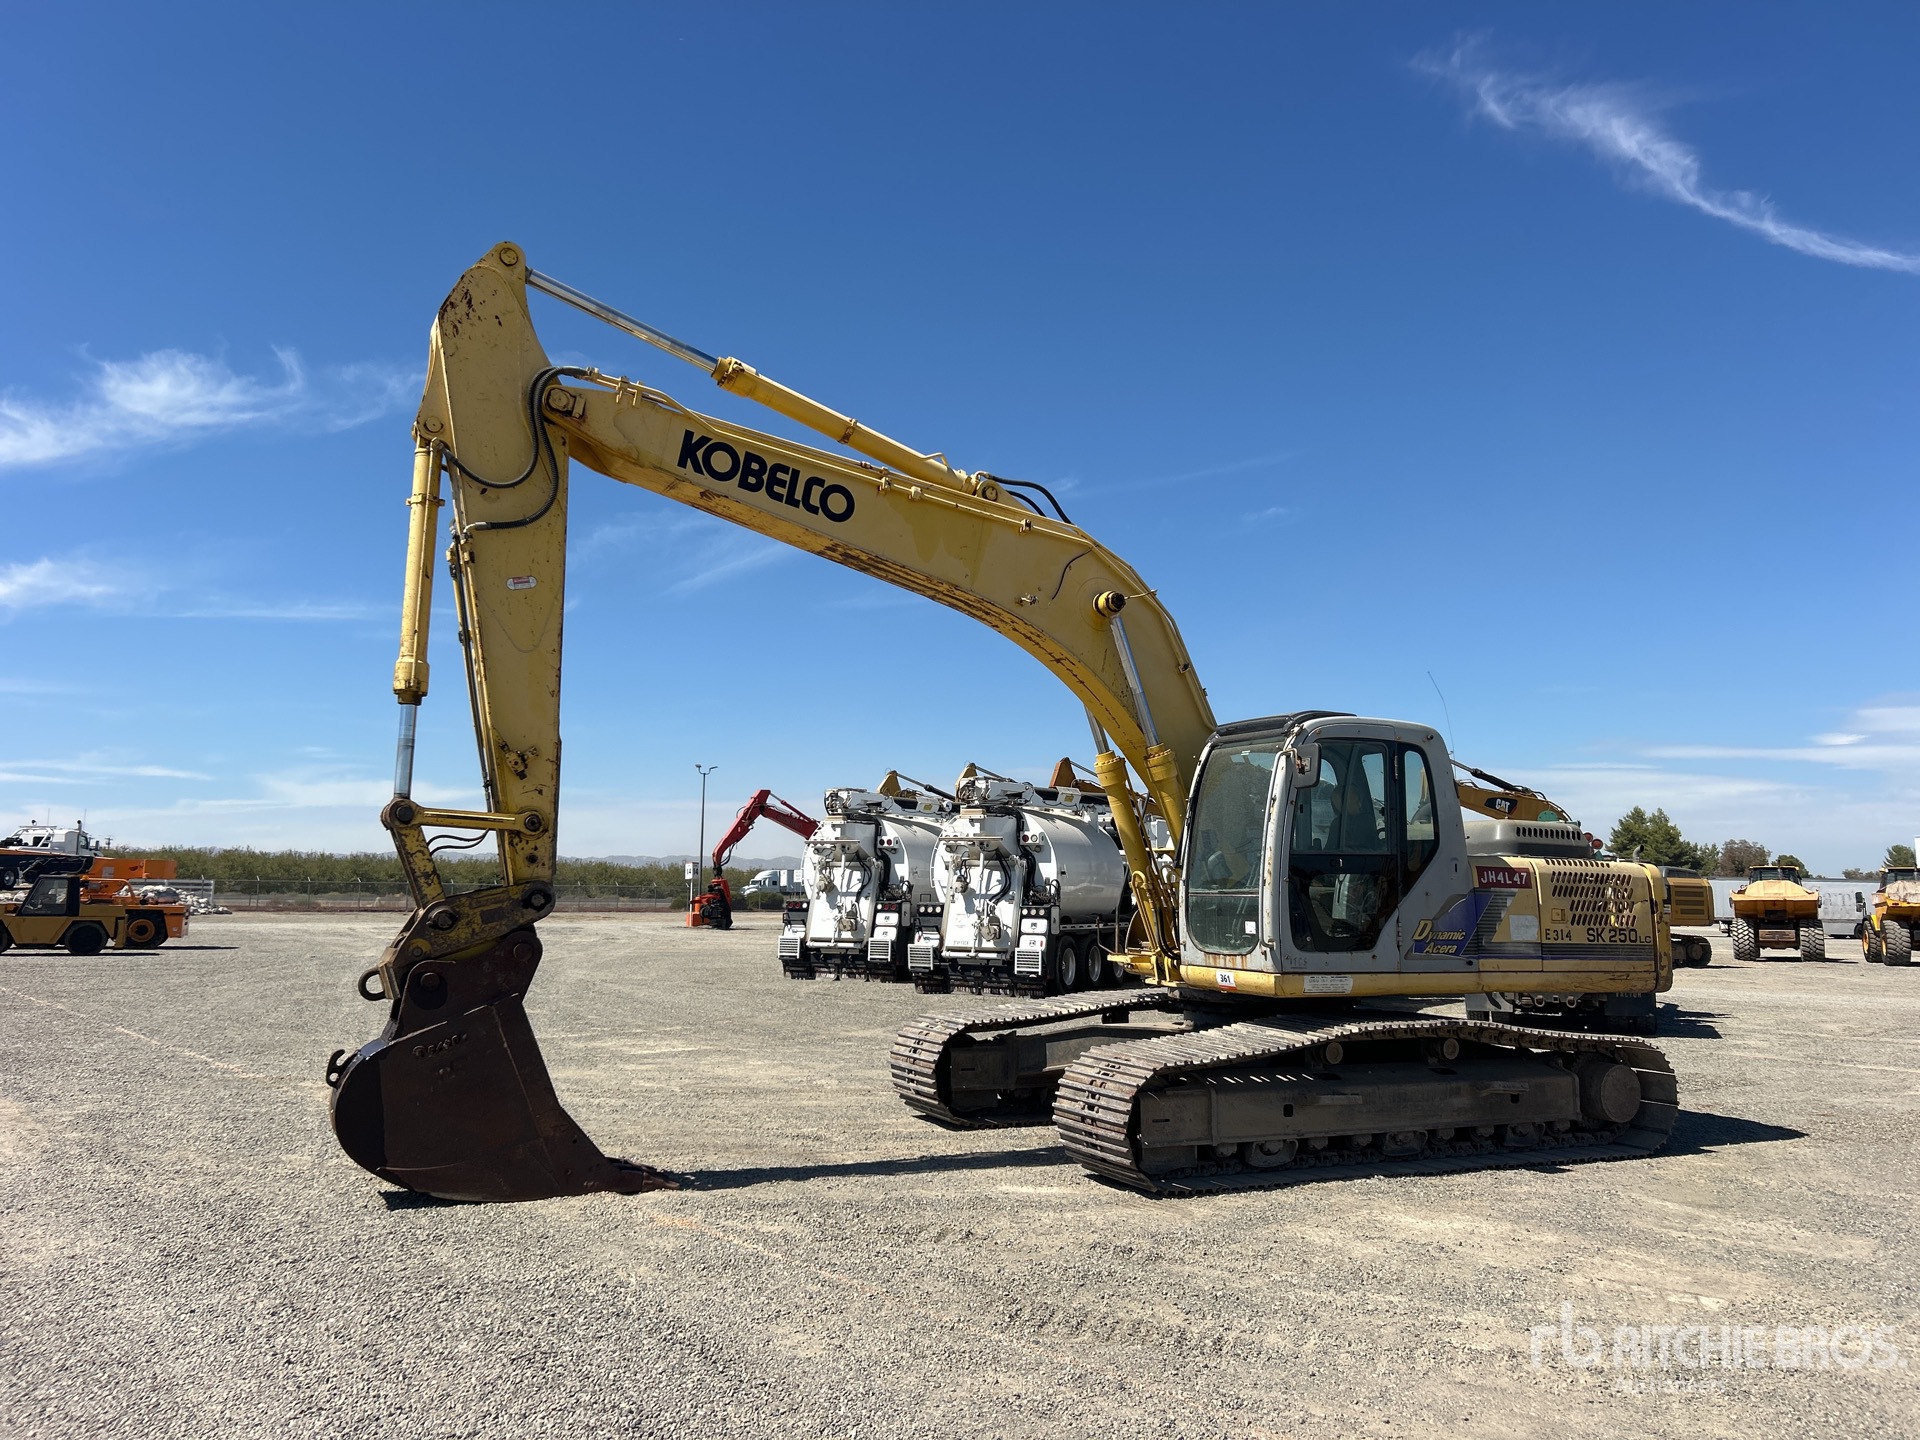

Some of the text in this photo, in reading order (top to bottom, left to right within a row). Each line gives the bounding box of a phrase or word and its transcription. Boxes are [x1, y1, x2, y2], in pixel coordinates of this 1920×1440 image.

[677, 429, 855, 522] KOBELCO
[1495, 799, 1510, 813] CAT
[1481, 871, 1527, 884] JH4L47
[1412, 919, 1466, 943] Dynamic
[1424, 942, 1458, 954] Acera
[1220, 973, 1231, 984] 361
